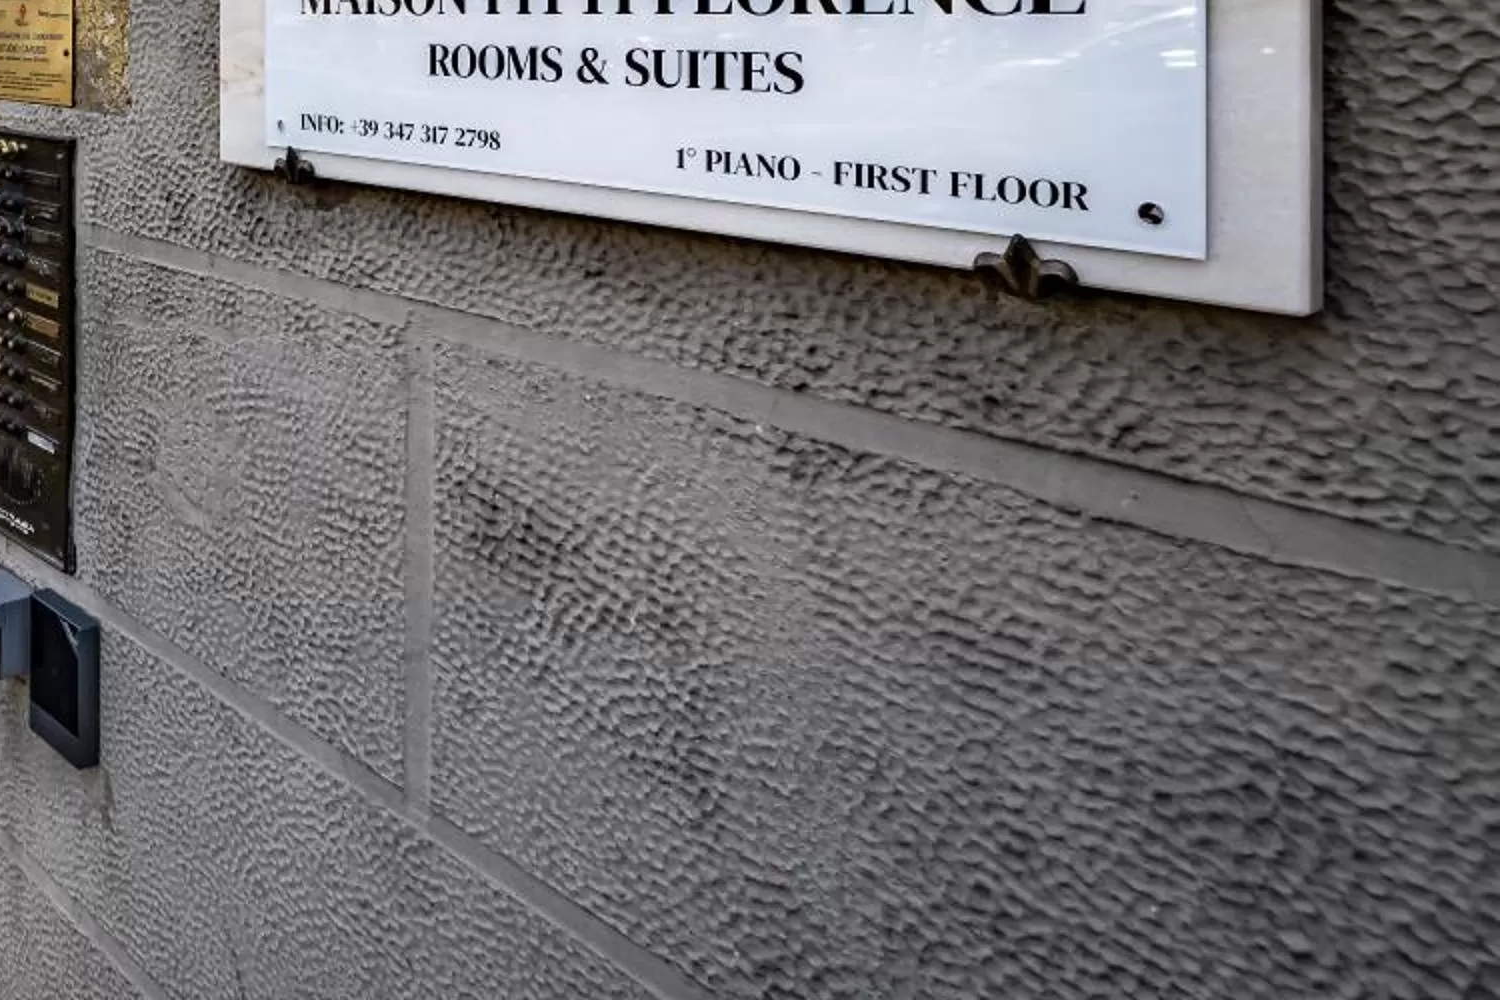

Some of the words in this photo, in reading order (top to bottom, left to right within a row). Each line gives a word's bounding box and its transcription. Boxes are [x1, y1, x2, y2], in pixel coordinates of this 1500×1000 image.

[429, 43, 563, 83] ROOMS
[576, 47, 610, 85] &
[625, 47, 805, 95] SUITES
[300, 113, 344, 134] INFO:
[350, 119, 379, 137] +39
[384, 121, 414, 142] 347
[420, 125, 449, 145] 317
[454, 127, 501, 151] 2798
[676, 147, 697, 169] 1°
[705, 149, 801, 181] PIANO
[833, 161, 938, 195] FIRST
[949, 171, 1090, 211] FLOOR
